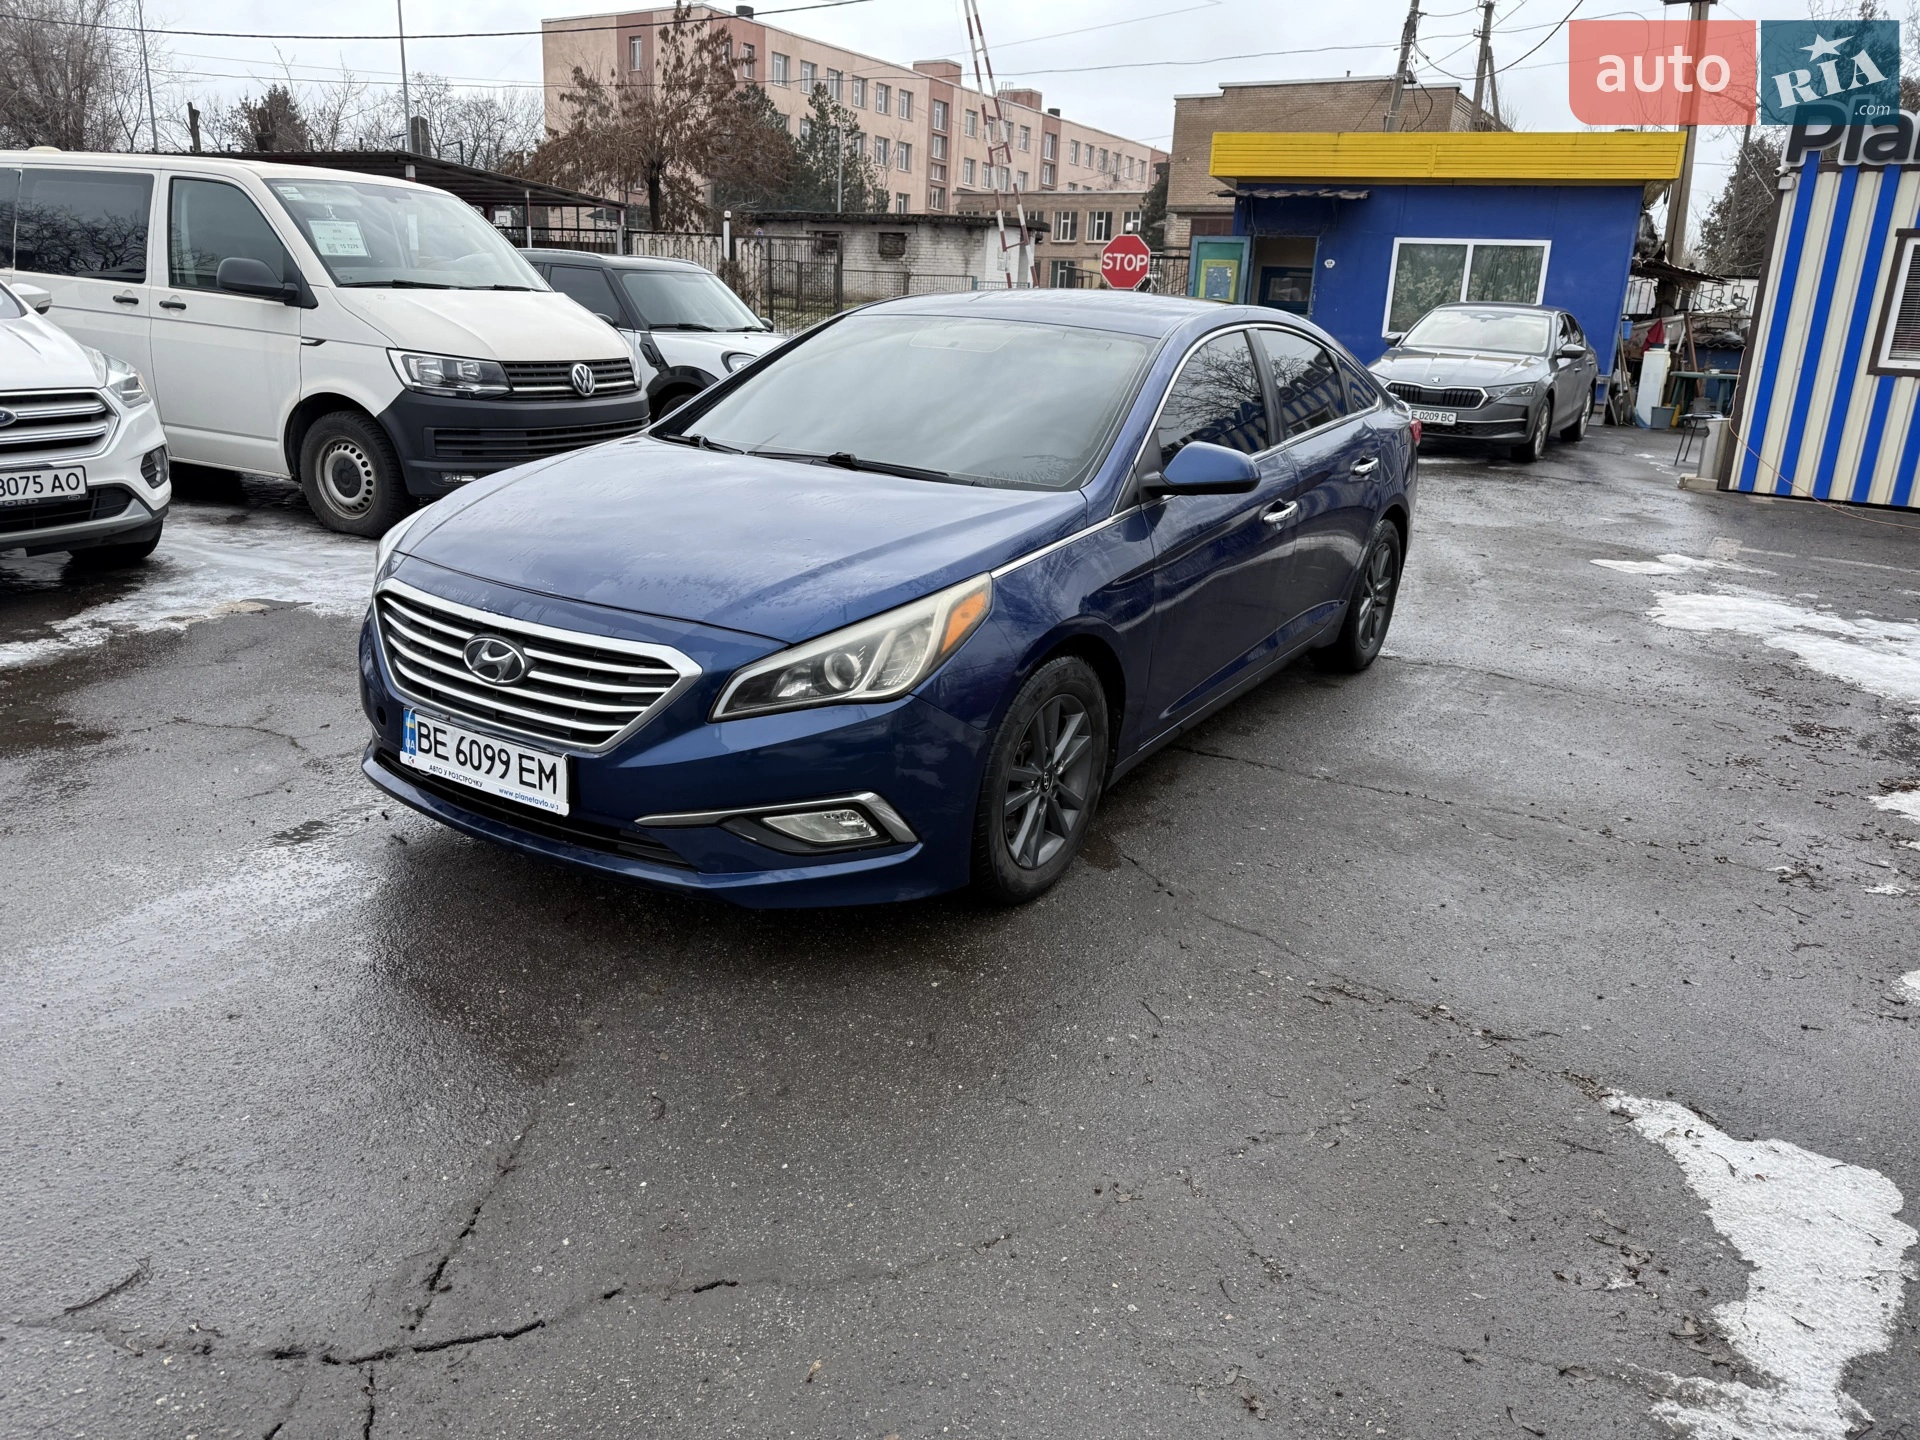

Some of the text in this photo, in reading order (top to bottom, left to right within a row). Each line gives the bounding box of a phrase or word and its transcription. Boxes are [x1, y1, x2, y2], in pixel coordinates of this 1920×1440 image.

[1785, 98, 1920, 163] Pla
[1102, 252, 1148, 272] STOP
[1419, 411, 1440, 421] 0209
[1440, 413, 1454, 423] BC
[50, 472, 80, 493] AO
[417, 721, 557, 795] BE 6099 EM
